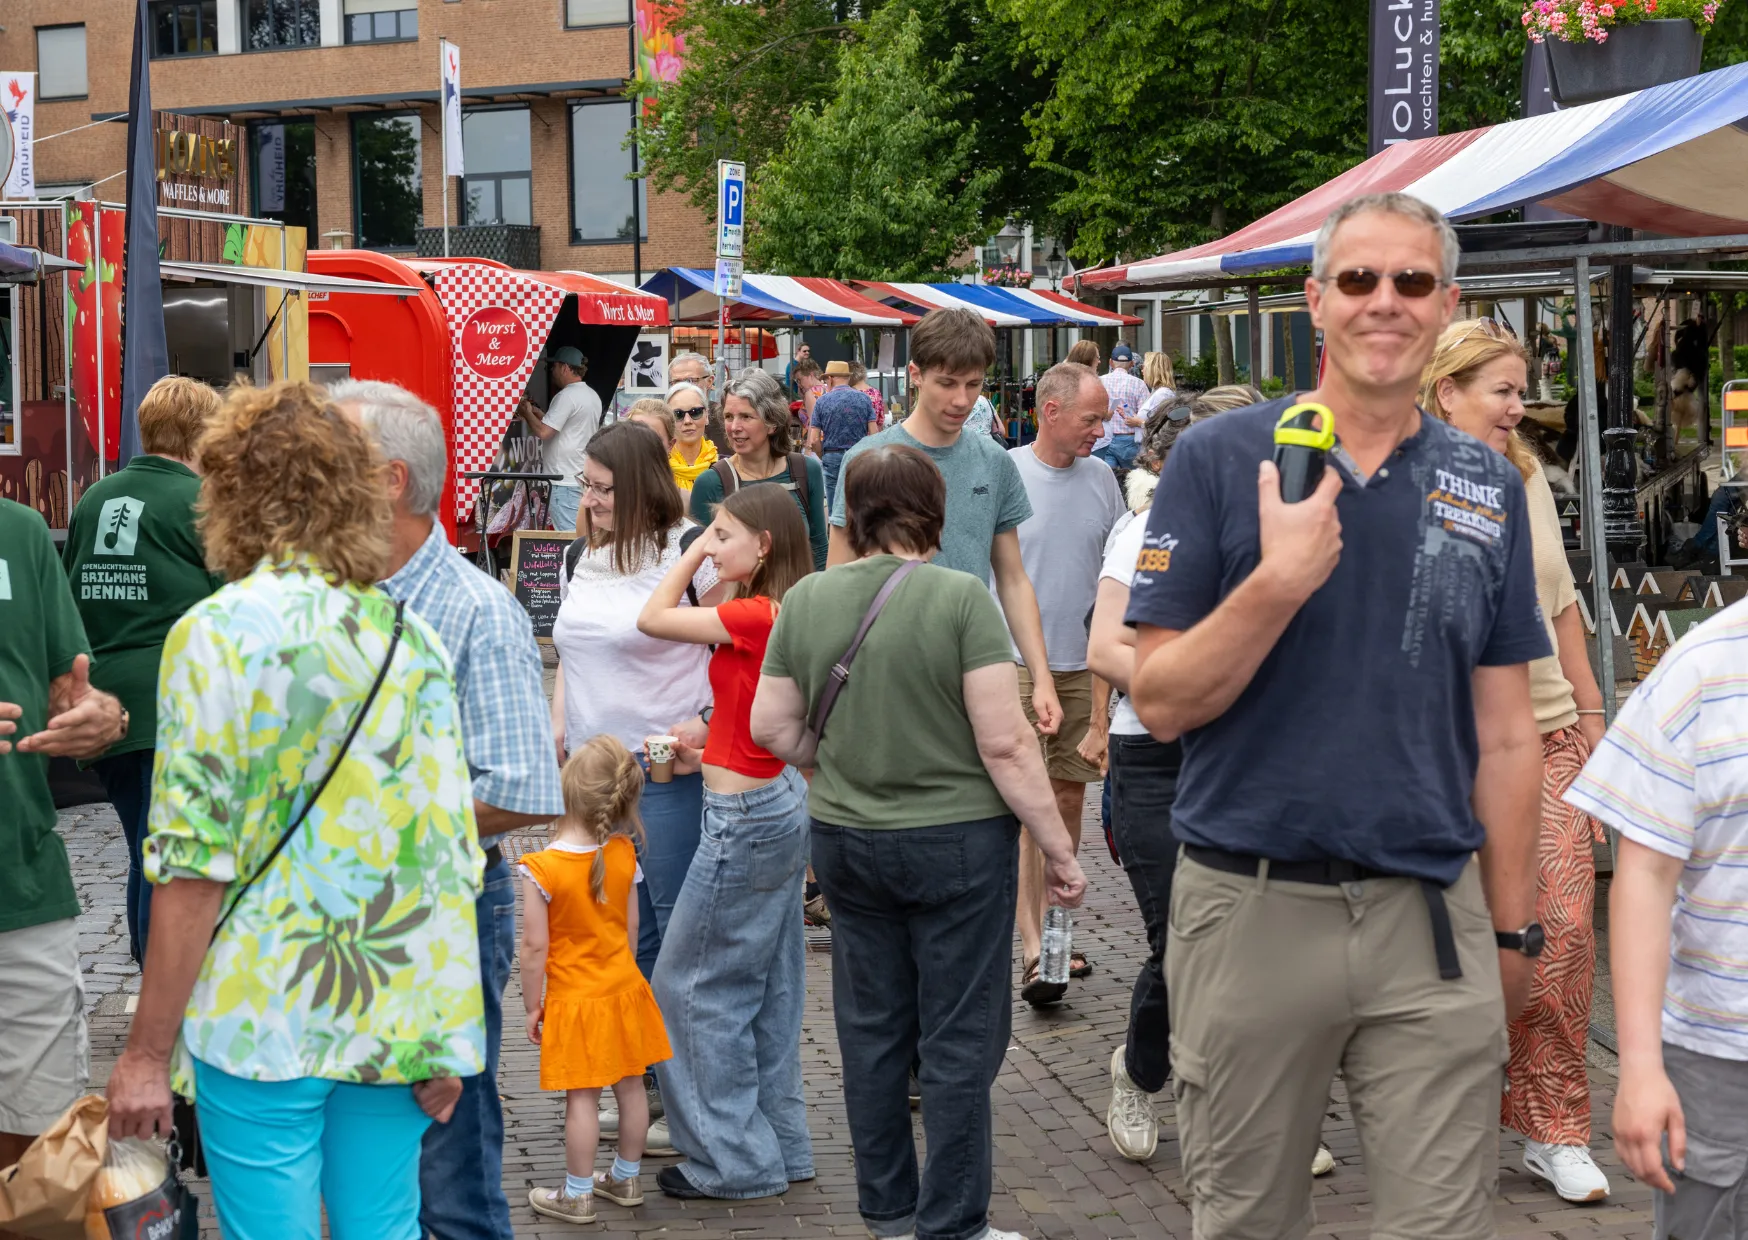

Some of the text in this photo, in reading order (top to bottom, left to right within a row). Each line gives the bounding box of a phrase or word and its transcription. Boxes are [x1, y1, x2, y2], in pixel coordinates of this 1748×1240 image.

[1420, 29, 1433, 45] &
[1419, 53, 1433, 130] vachten
[728, 167, 741, 177] ZONE
[162, 181, 230, 206] WAFFLES & MORE
[729, 185, 740, 220] P
[597, 300, 655, 322] Worst & Meer
[472, 320, 516, 335] Worst
[489, 337, 501, 350] &
[475, 353, 515, 366] Meer
[1436, 468, 1501, 509] THINK
[533, 543, 560, 552] Wafels
[81, 571, 147, 584] BRILMANS
[81, 585, 148, 600] DENNEN
